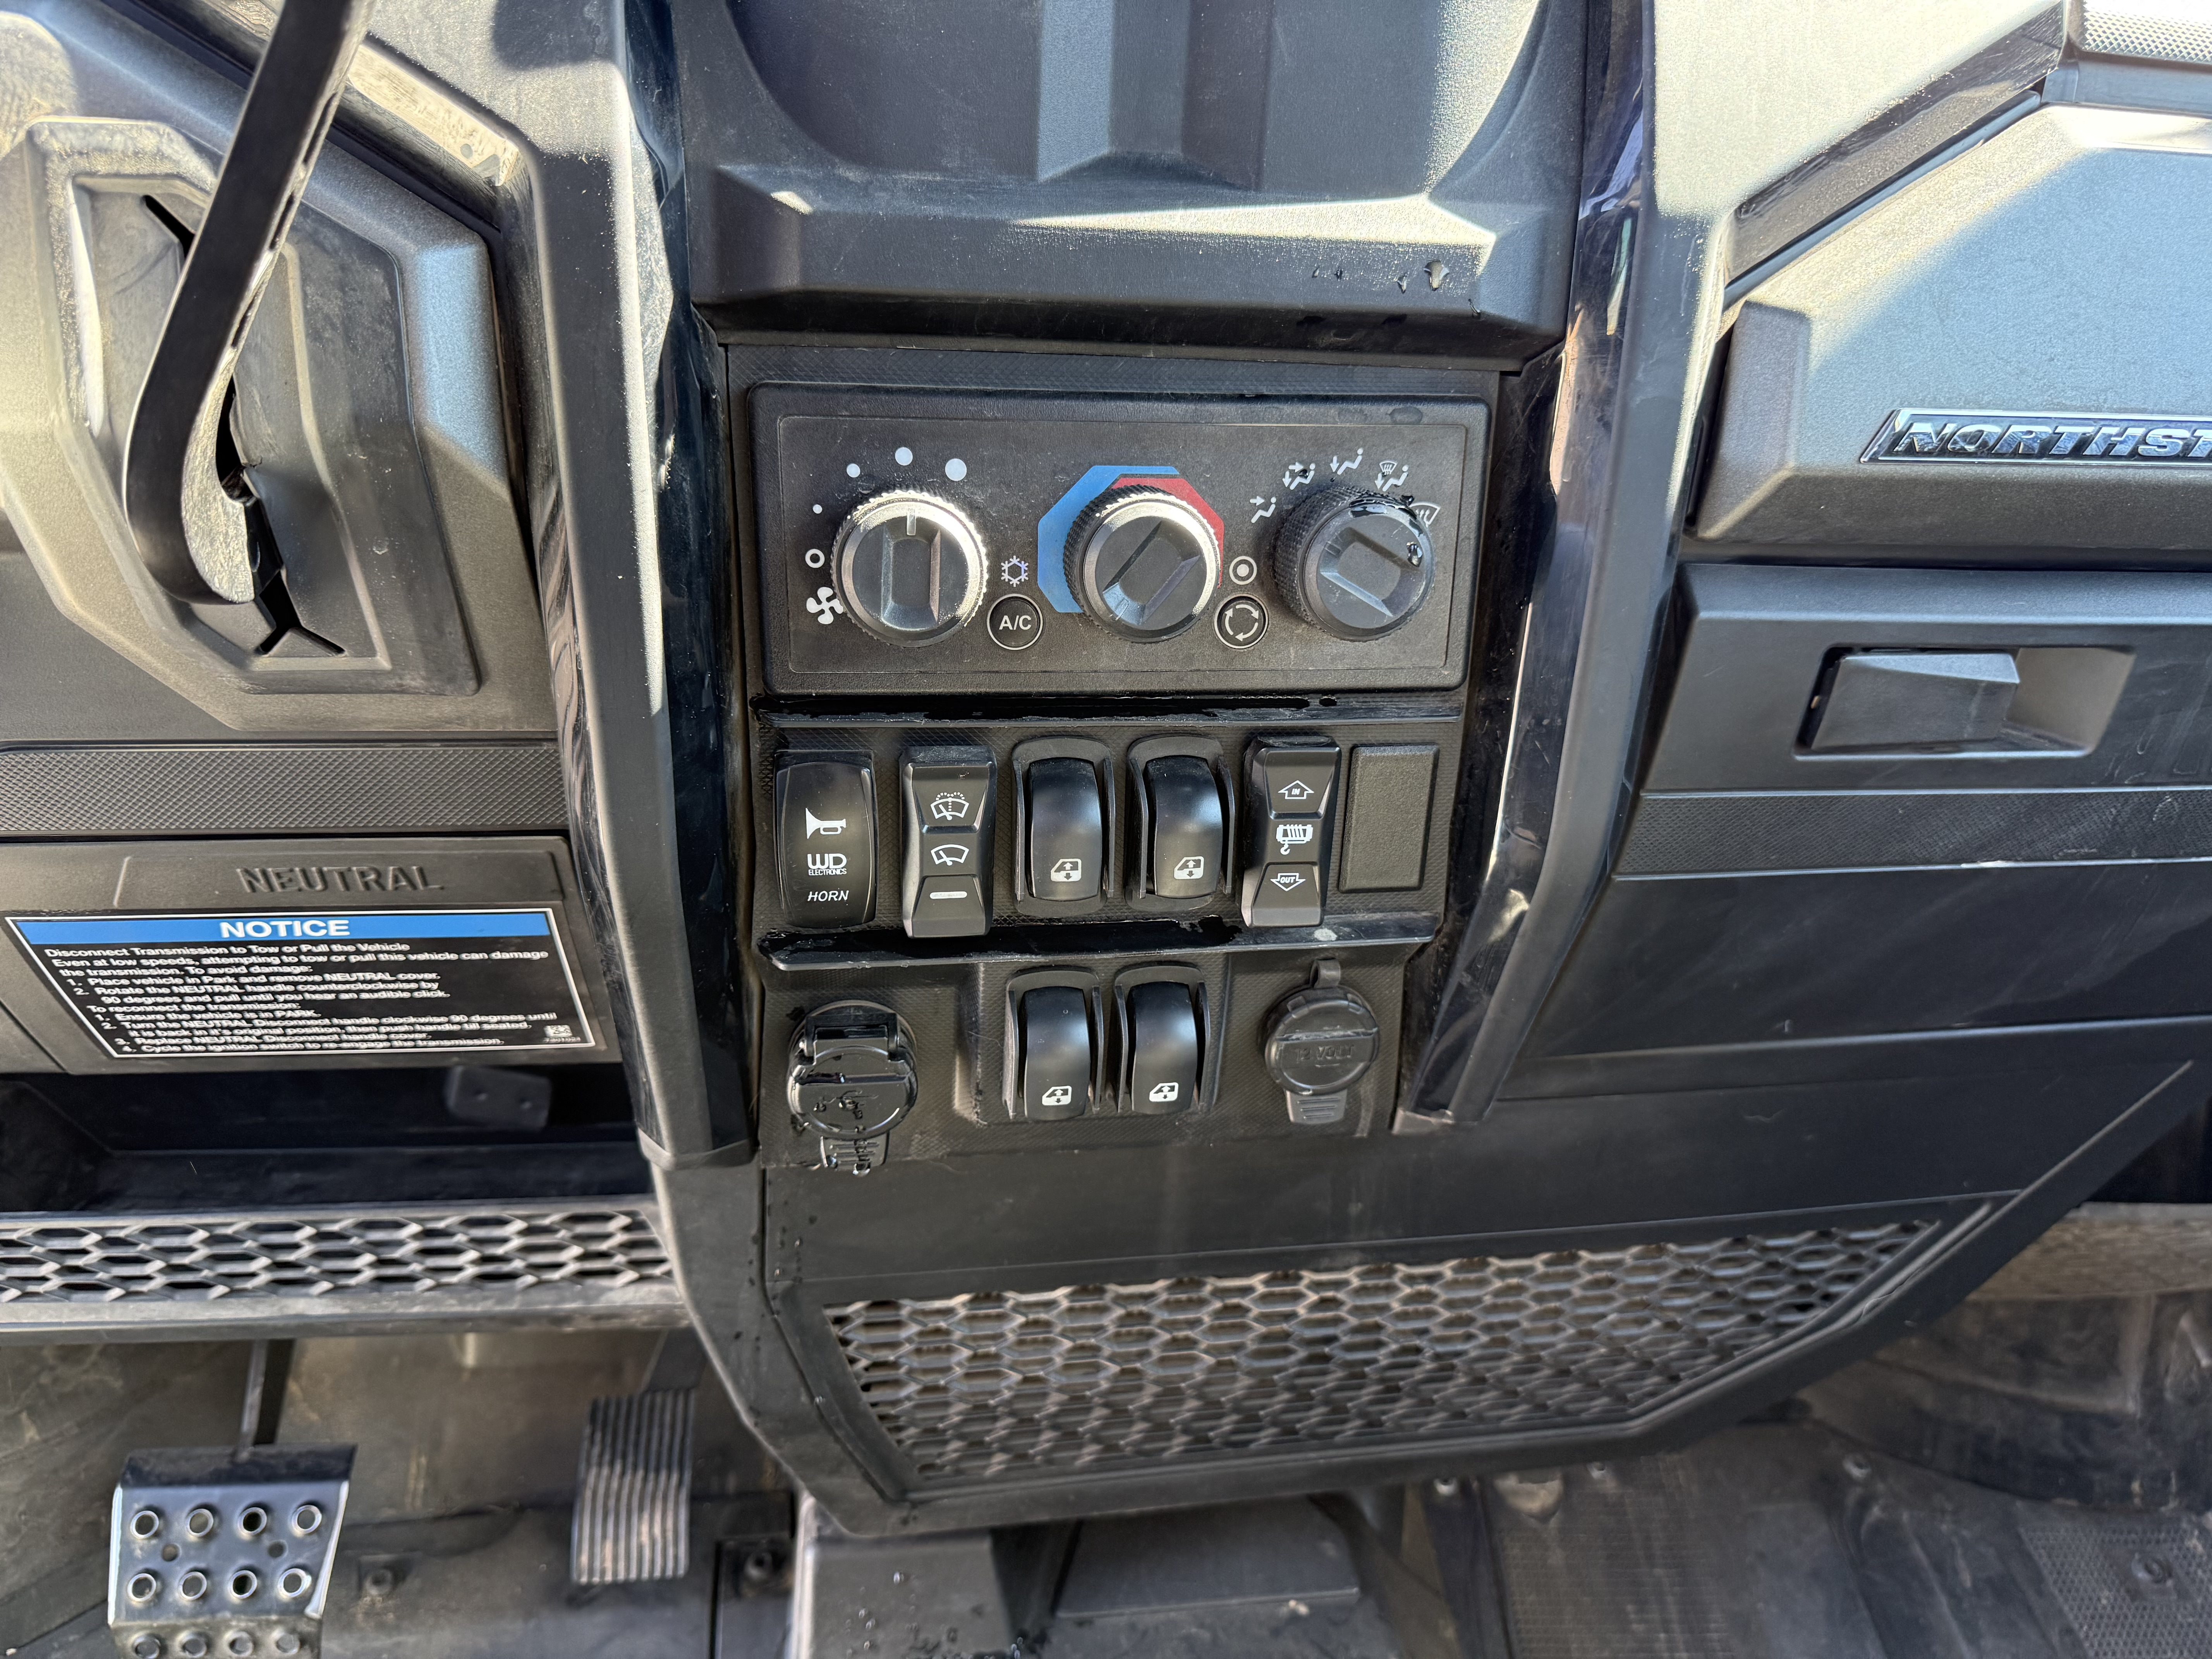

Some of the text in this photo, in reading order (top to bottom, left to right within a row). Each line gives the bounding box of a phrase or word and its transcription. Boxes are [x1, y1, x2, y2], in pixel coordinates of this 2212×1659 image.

[999, 615, 1032, 630] A/C
[807, 854, 847, 869] WD
[237, 866, 444, 893] NEUTRAL
[807, 890, 849, 901] HORN
[220, 920, 350, 938] NOTICE
[45, 949, 131, 957] Disconnect
[129, 946, 229, 955] Transmission
[246, 945, 279, 953] Tow
[299, 944, 330, 952] Pull
[330, 944, 356, 952] the
[356, 943, 410, 951] Vehicle
[52, 959, 91, 967] Even
[140, 957, 199, 967] speeds,
[200, 955, 281, 965] attempting
[348, 953, 376, 963] pull
[376, 953, 406, 961] this
[407, 952, 459, 960] vehicle
[489, 951, 548, 960] damage
[86, 967, 184, 976] transmission.
[207, 966, 248, 974] avoid
[247, 965, 313, 974] damage:
[131, 976, 184, 985] vehicle
[201, 975, 237, 984] Park
[238, 975, 268, 983] and
[323, 972, 397, 981] NEUTRAL
[172, 985, 245, 993] NEUTRAL
[296, 981, 419, 991] counterclockwise
[418, 981, 439, 990] by
[123, 996, 182, 1005] degrees
[182, 994, 212, 1003] and
[213, 994, 241, 1003] pull
[241, 993, 274, 1001] until
[274, 994, 303, 1002] you
[303, 992, 337, 1000] hear
[358, 991, 411, 1000] audible
[411, 990, 450, 998] click.
[181, 1020, 253, 1028] NEUTRAL
[252, 1018, 331, 1027] Disconnect
[380, 1015, 448, 1024] clockwise
[448, 1015, 468, 1023] 90
[468, 1014, 526, 1023] degrees
[525, 1012, 557, 1021] until
[1297, 1045, 1355, 1060] 12 VOLT
